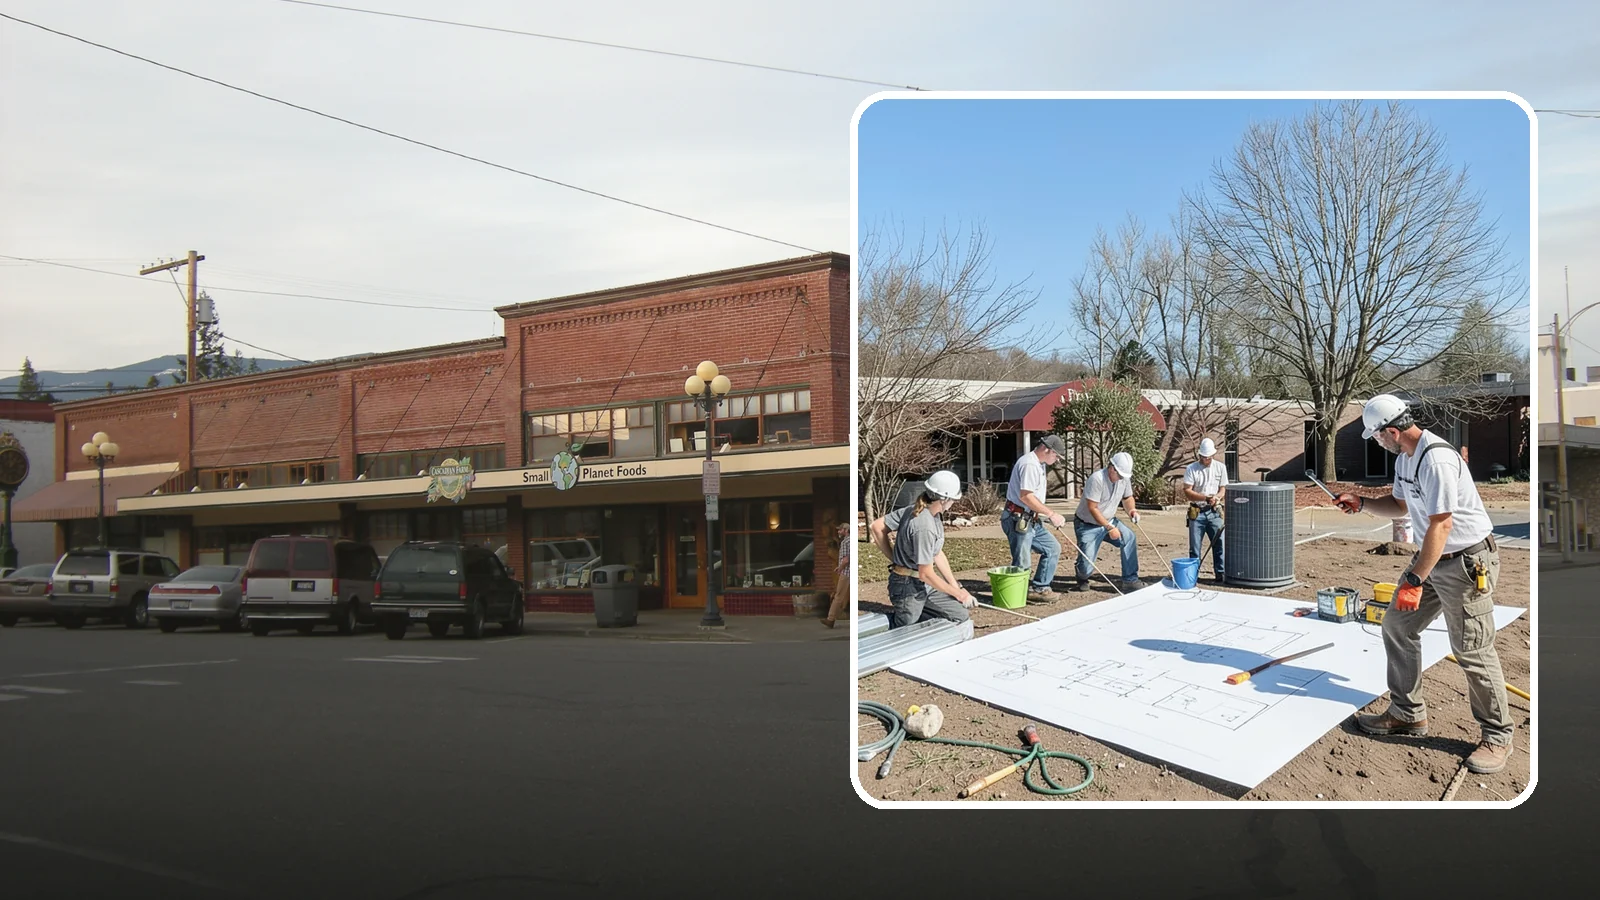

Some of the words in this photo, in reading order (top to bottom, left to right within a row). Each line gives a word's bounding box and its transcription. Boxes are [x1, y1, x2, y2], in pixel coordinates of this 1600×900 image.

[523, 471, 549, 483] Small
[583, 467, 614, 479] Planet
[617, 464, 647, 477] Foods
